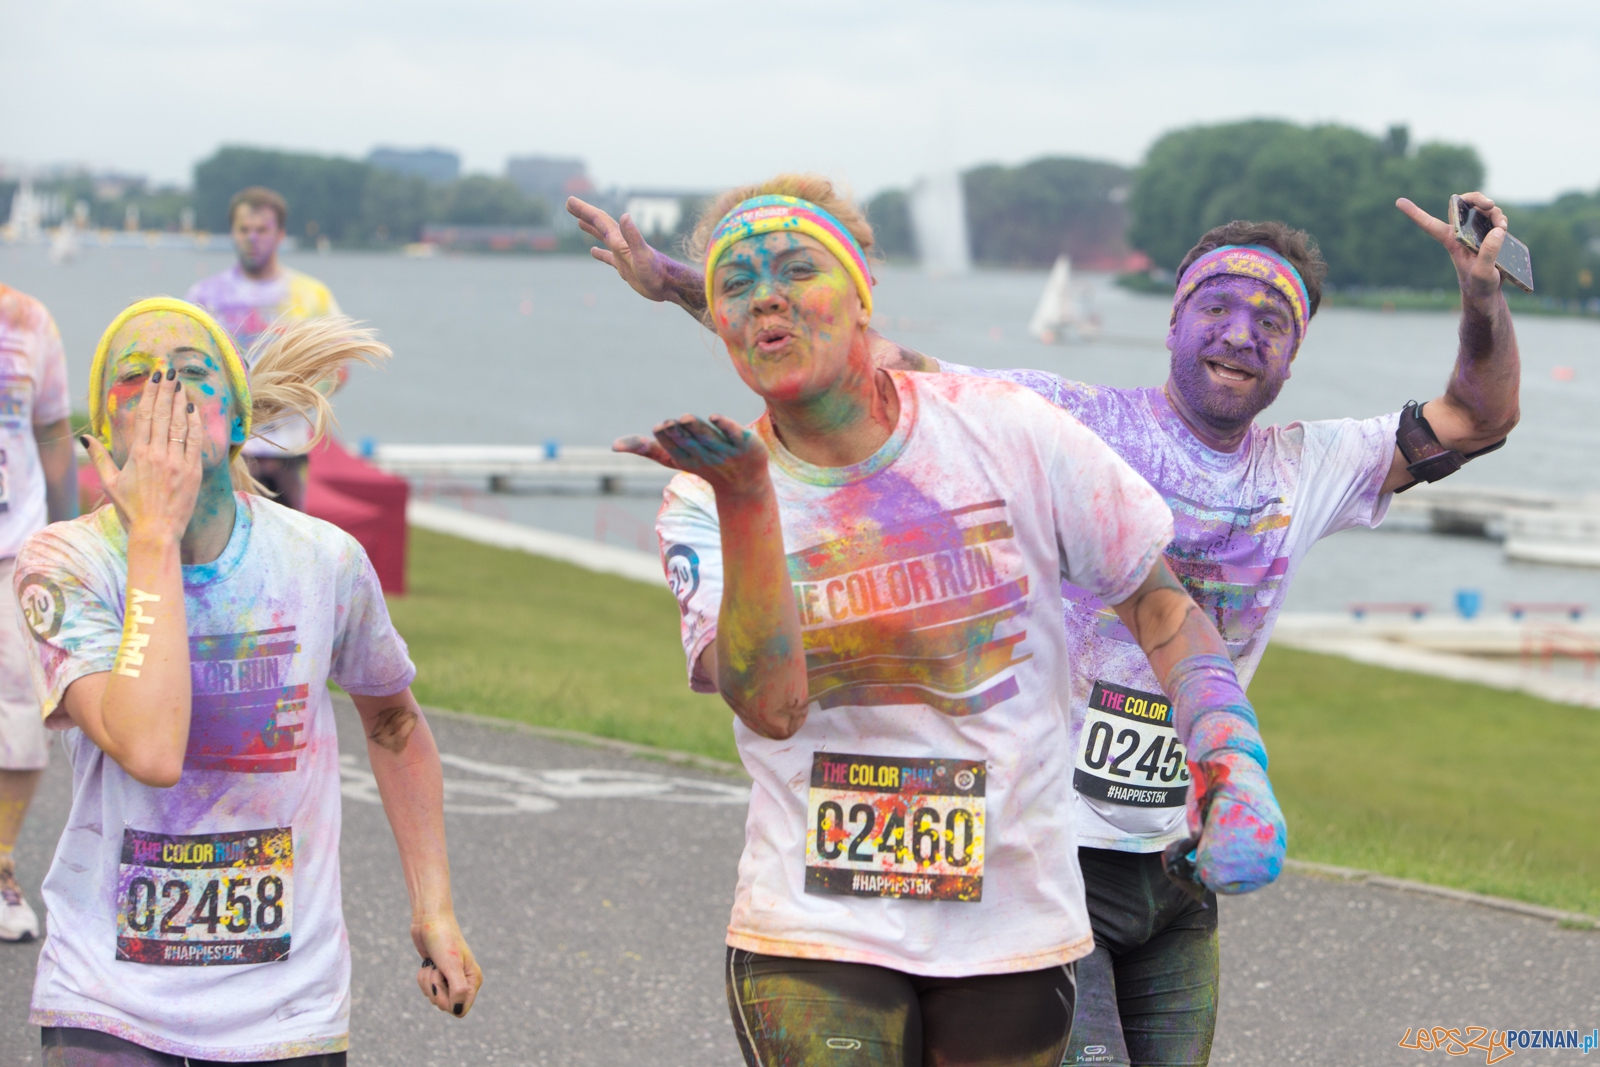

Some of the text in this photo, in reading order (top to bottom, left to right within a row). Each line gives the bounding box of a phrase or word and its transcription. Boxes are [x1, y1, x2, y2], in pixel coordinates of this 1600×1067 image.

[826, 559, 933, 620] COLOR
[117, 587, 161, 677] HAPPY
[1100, 689, 1125, 711] THE
[1124, 697, 1168, 721] COLOR
[822, 762, 848, 784] THE
[849, 764, 899, 787] COLOR
[1107, 785, 1168, 803] #HAPPIEST5K
[816, 800, 974, 868] 02460
[133, 839, 162, 862] THE
[163, 843, 214, 863] COLOR
[127, 875, 284, 934] 02458
[164, 945, 245, 960] #HAPPIEST5K
